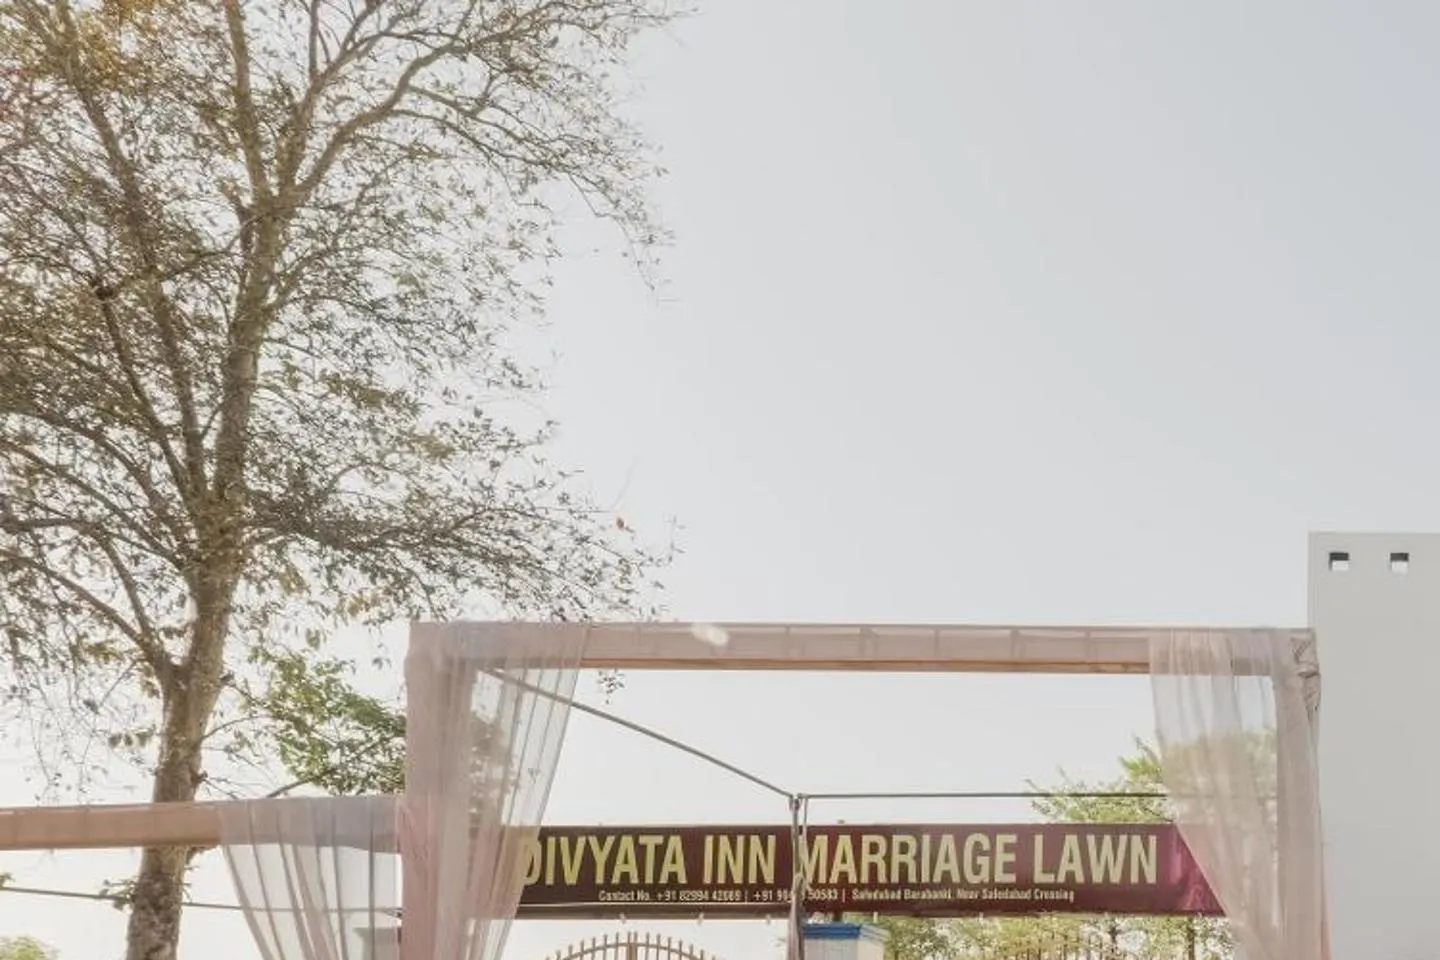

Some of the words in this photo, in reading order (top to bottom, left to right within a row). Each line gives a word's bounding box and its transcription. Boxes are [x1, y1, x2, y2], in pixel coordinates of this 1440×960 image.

[518, 834, 688, 886] DIVYATA
[703, 834, 777, 885] INN
[797, 833, 1017, 885] MARRIAGE
[1034, 834, 1158, 884] LAWN
[599, 889, 635, 901] Contact
[753, 890, 774, 901] +91
